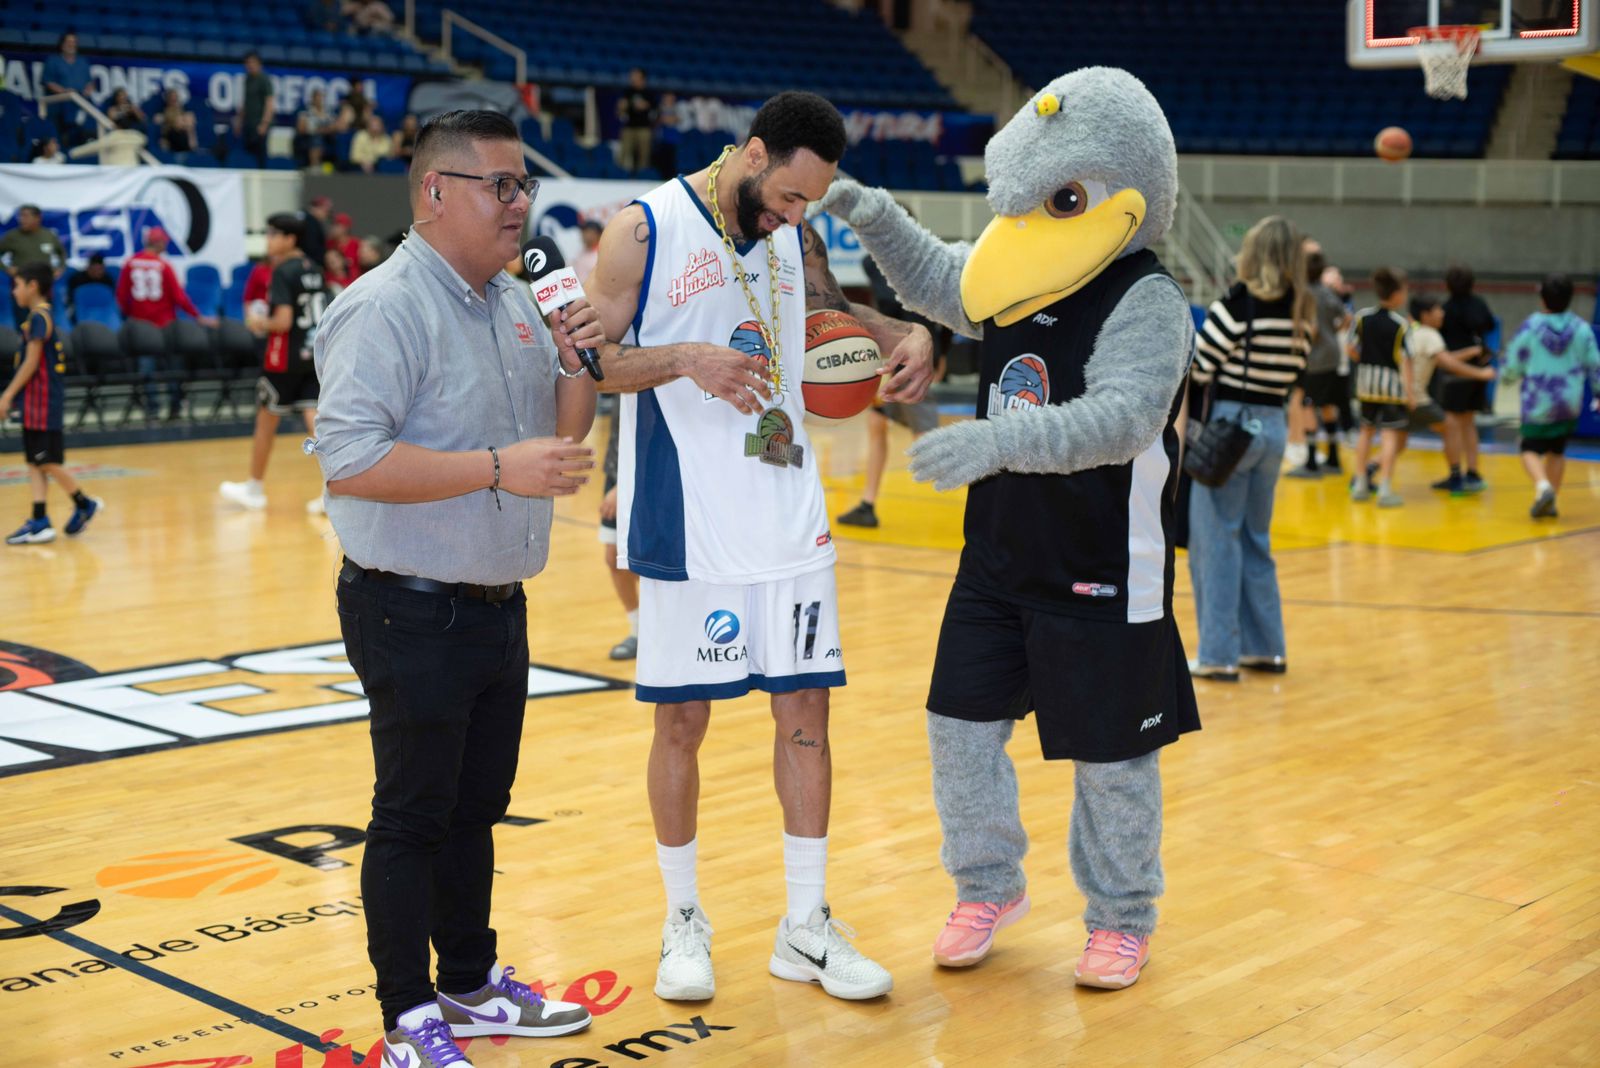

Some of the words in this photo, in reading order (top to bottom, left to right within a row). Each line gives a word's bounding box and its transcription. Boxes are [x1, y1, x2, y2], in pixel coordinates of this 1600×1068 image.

[685, 248, 718, 277] Salsa
[668, 259, 725, 307] Huichol
[1032, 312, 1059, 327] ADX
[816, 348, 880, 370] CIBACOPA
[793, 600, 821, 664] 11
[697, 645, 748, 662] MEGA
[825, 648, 843, 659] AD
[1139, 713, 1163, 732] ADX
[121, 943, 199, 963] de
[195, 894, 364, 943] Básq
